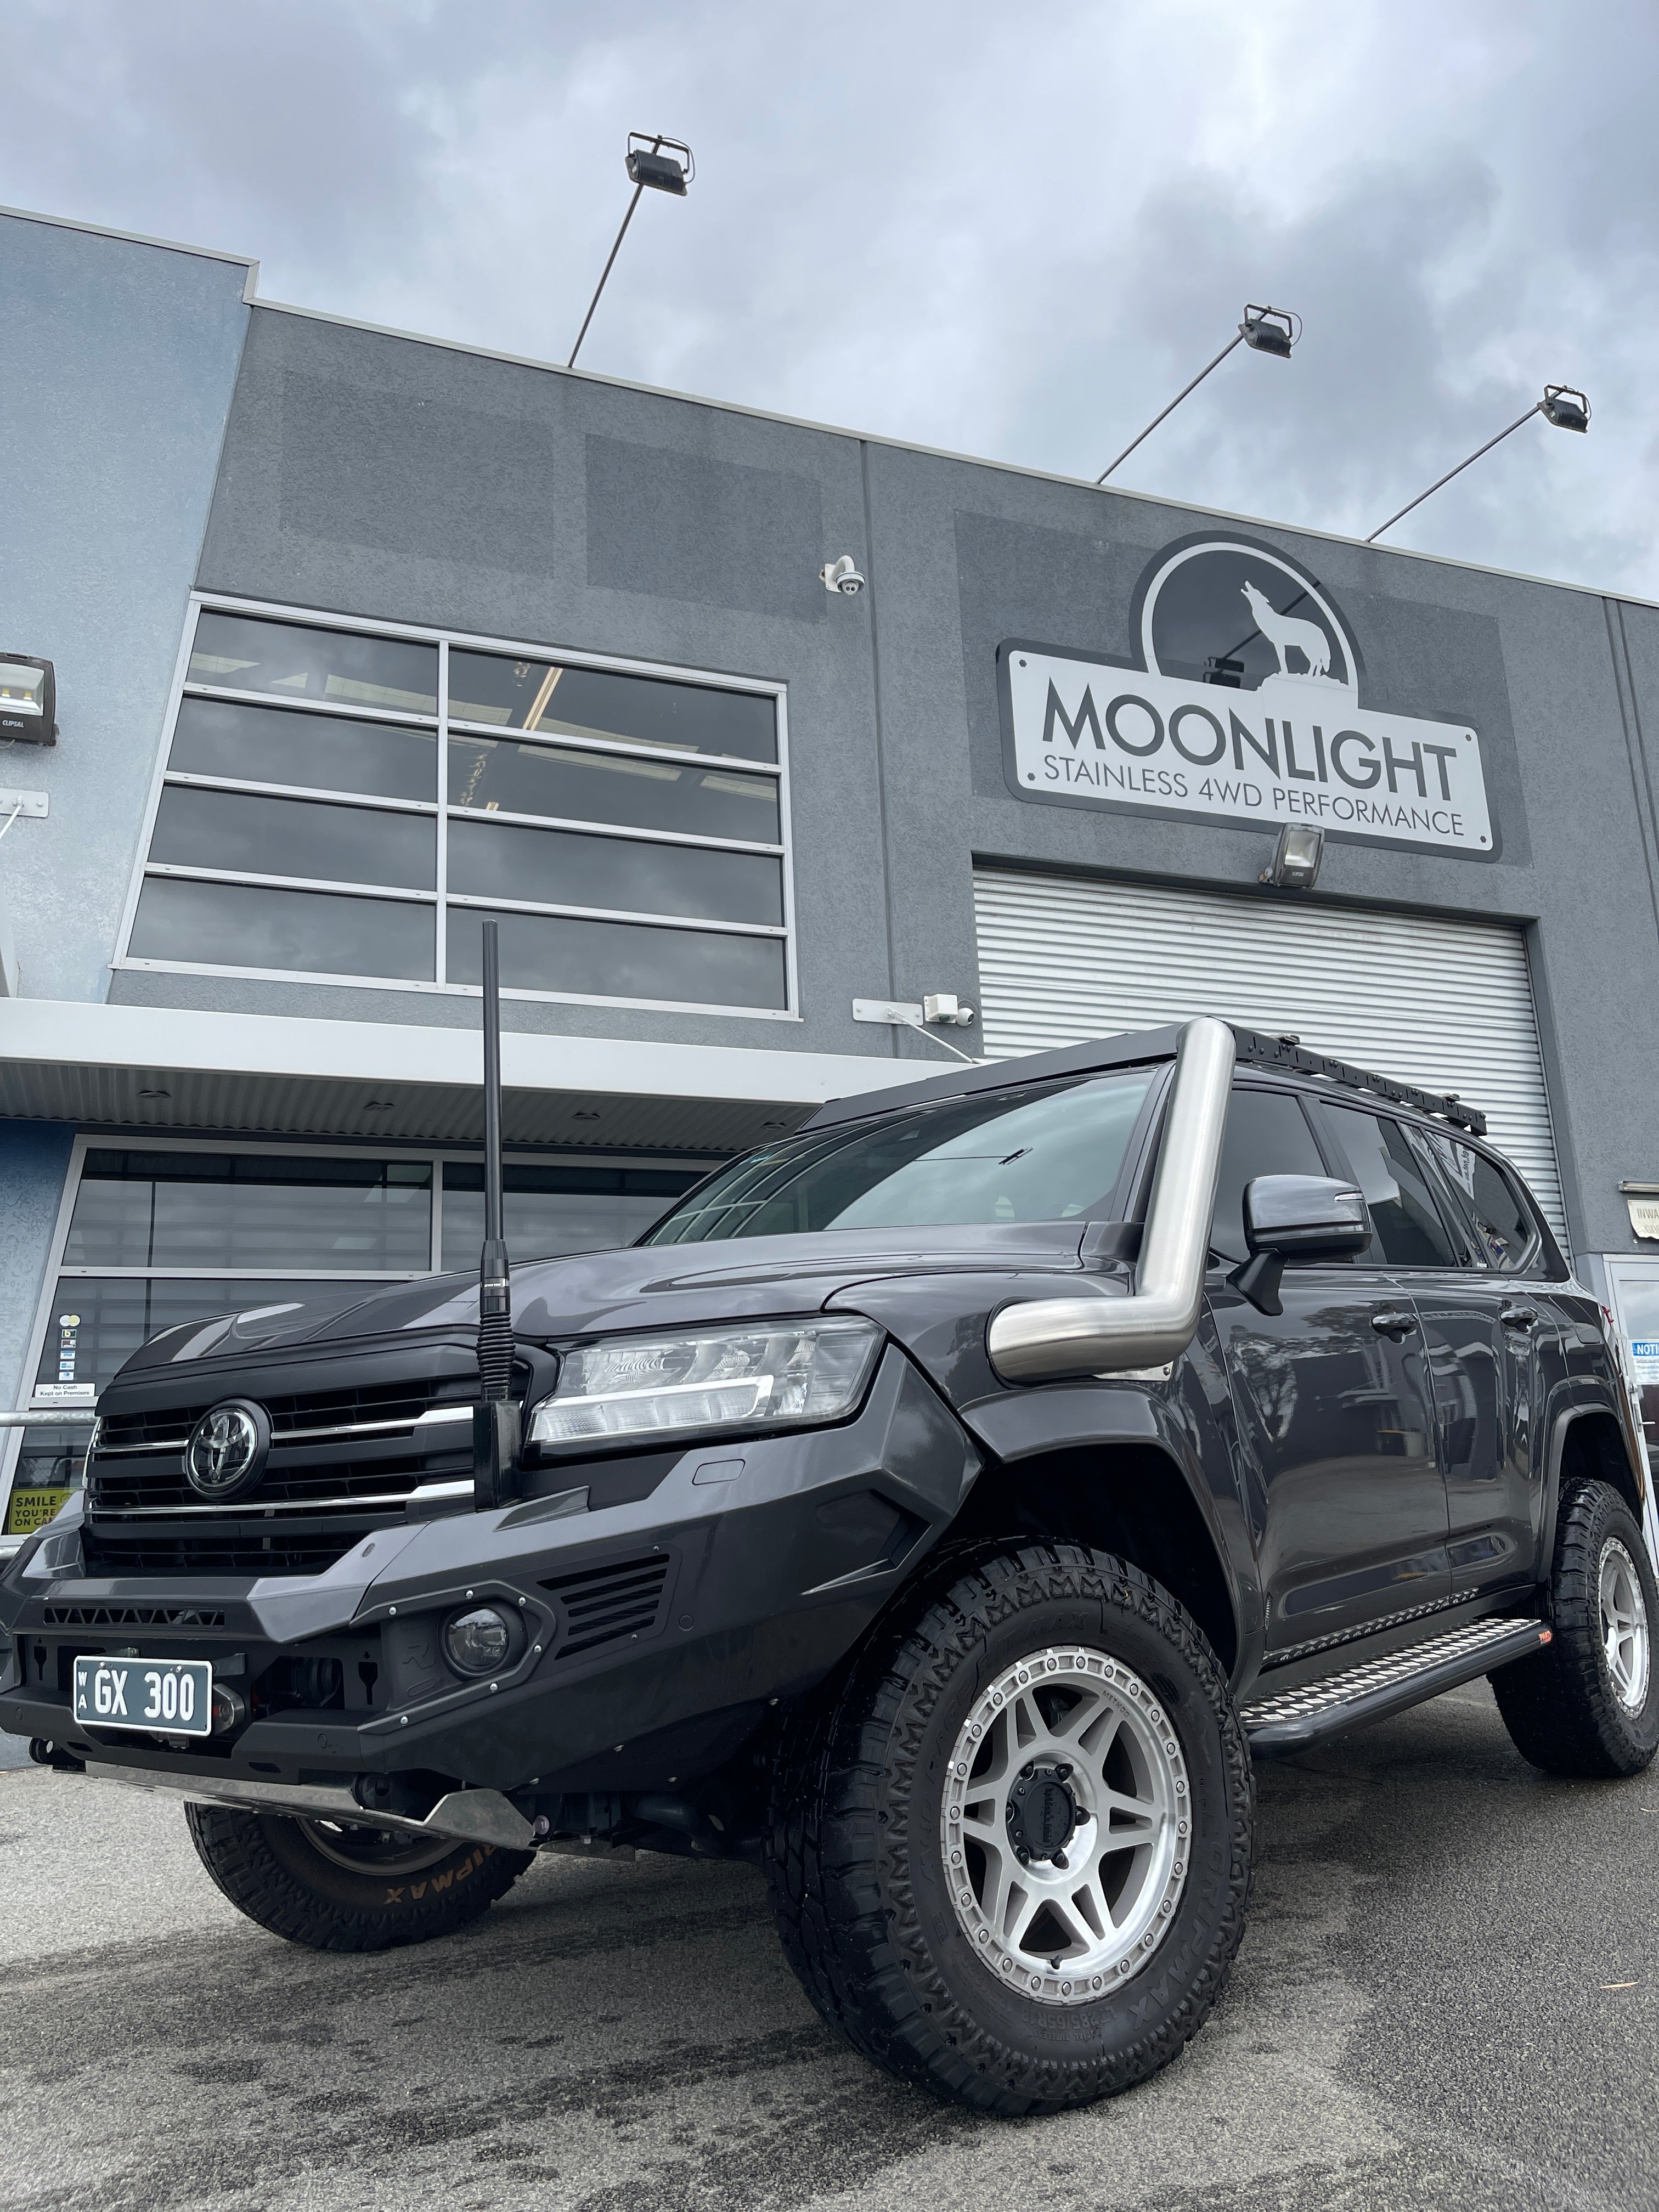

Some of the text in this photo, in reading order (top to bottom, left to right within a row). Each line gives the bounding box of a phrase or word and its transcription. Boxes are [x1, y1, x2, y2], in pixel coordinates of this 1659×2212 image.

[1042, 676, 1457, 802] MOONLIGHT
[1045, 755, 1464, 836] STAINLESS 4WD PERFORMANCE
[1637, 1344, 1659, 1355] NOTI
[15, 1509, 56, 1517] YOU'RE
[16, 1496, 57, 1507] SMILE
[95, 1669, 195, 1722] GX 300
[1128, 1842, 1225, 2030] GRIPMAX
